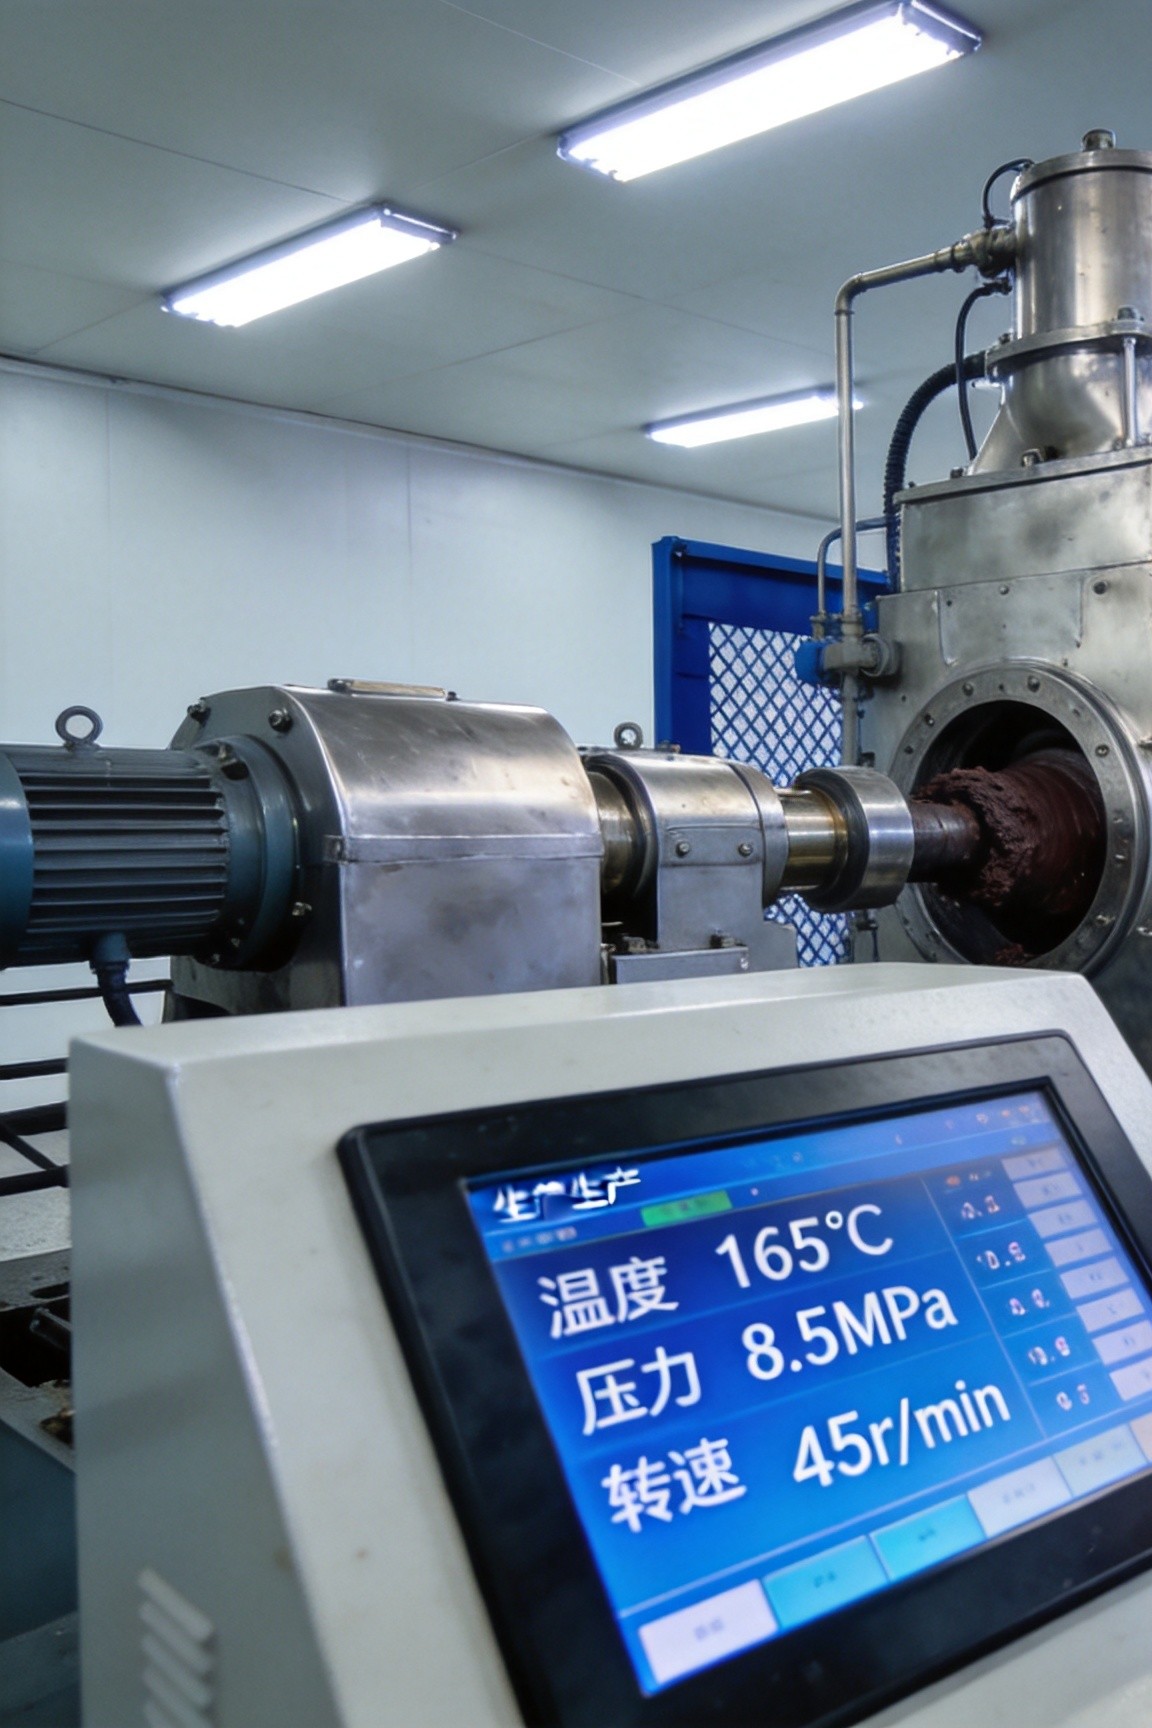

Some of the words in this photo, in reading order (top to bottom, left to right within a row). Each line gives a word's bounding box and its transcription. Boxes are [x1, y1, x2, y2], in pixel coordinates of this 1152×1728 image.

[537, 1255, 680, 1340] 温度
[574, 1345, 703, 1436] 压力
[740, 1284, 959, 1382] 8.5MPa
[601, 1437, 747, 1534] 转速
[791, 1380, 1012, 1488] 45r/min
